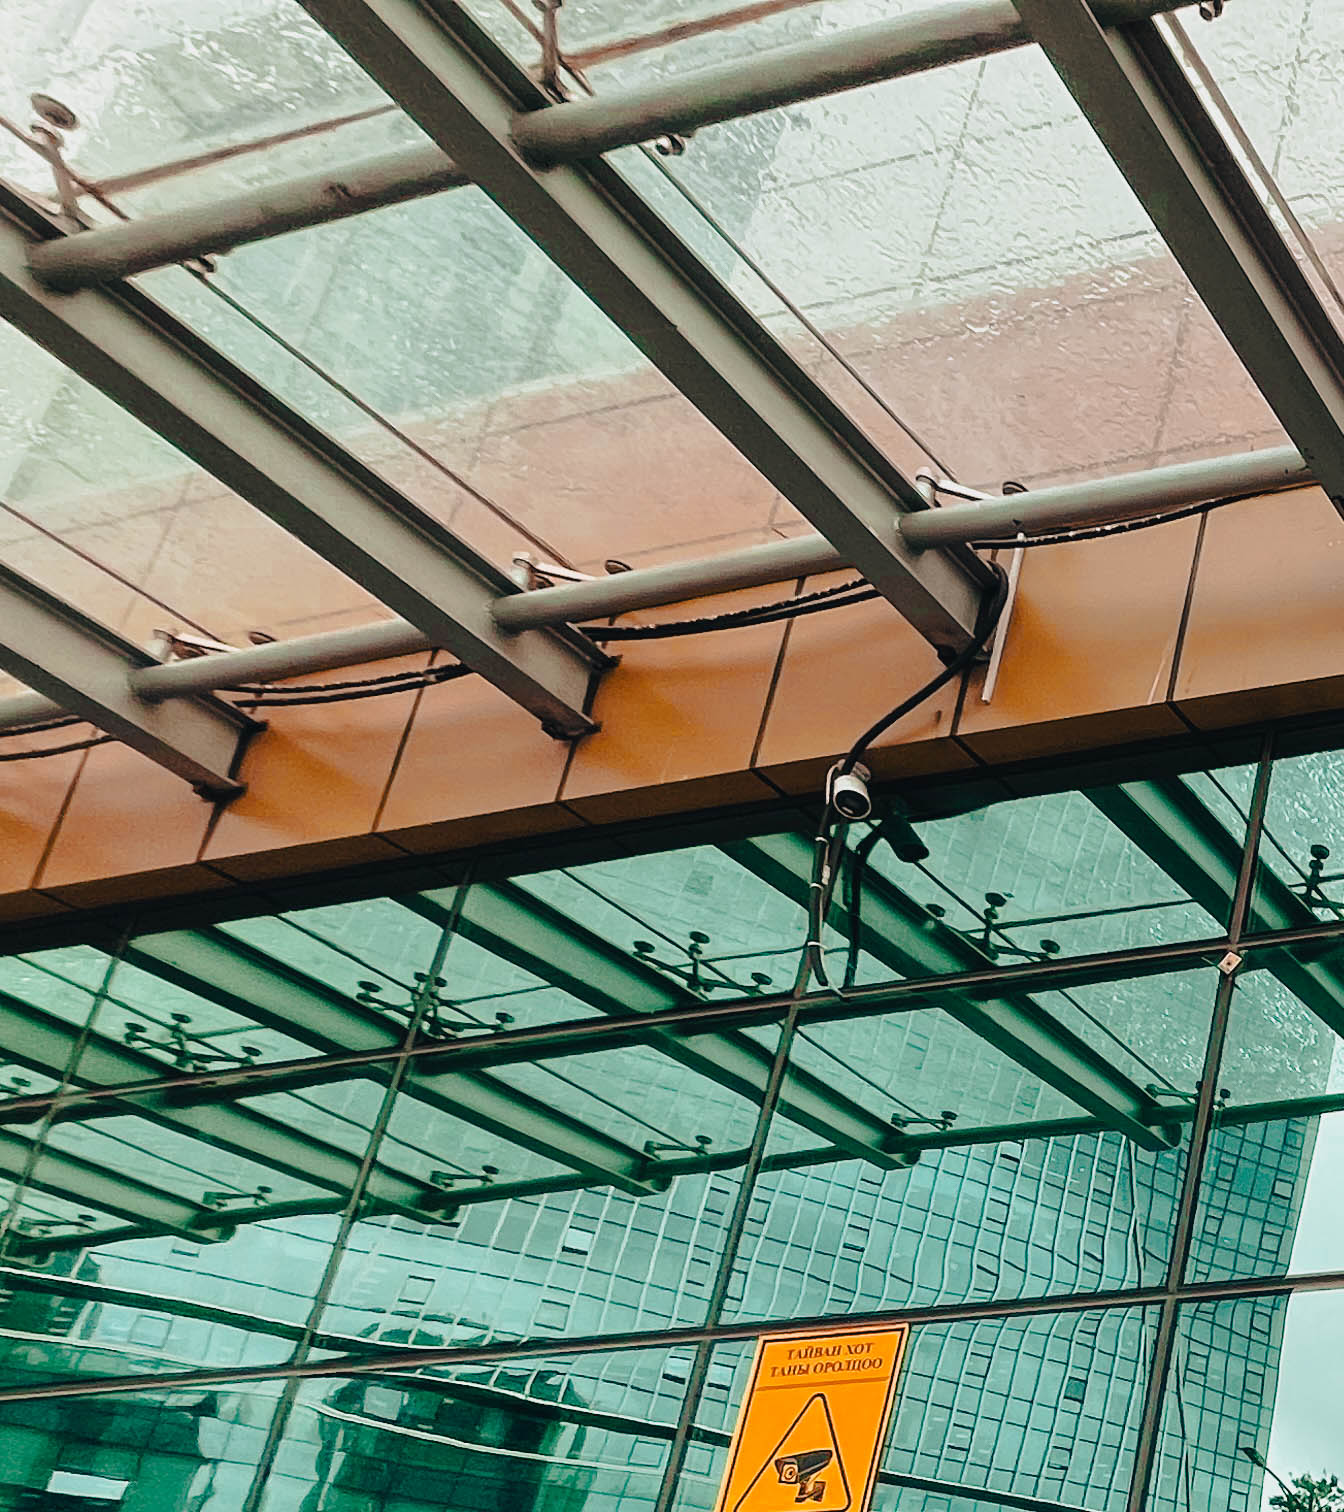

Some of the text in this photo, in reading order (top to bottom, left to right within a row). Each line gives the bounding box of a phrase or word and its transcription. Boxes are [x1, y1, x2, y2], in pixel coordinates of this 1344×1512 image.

[788, 1342, 874, 1360] ТАЙВАН ХОТ
[771, 1358, 883, 1377] ТАНЫ ОРОЛЦОО
